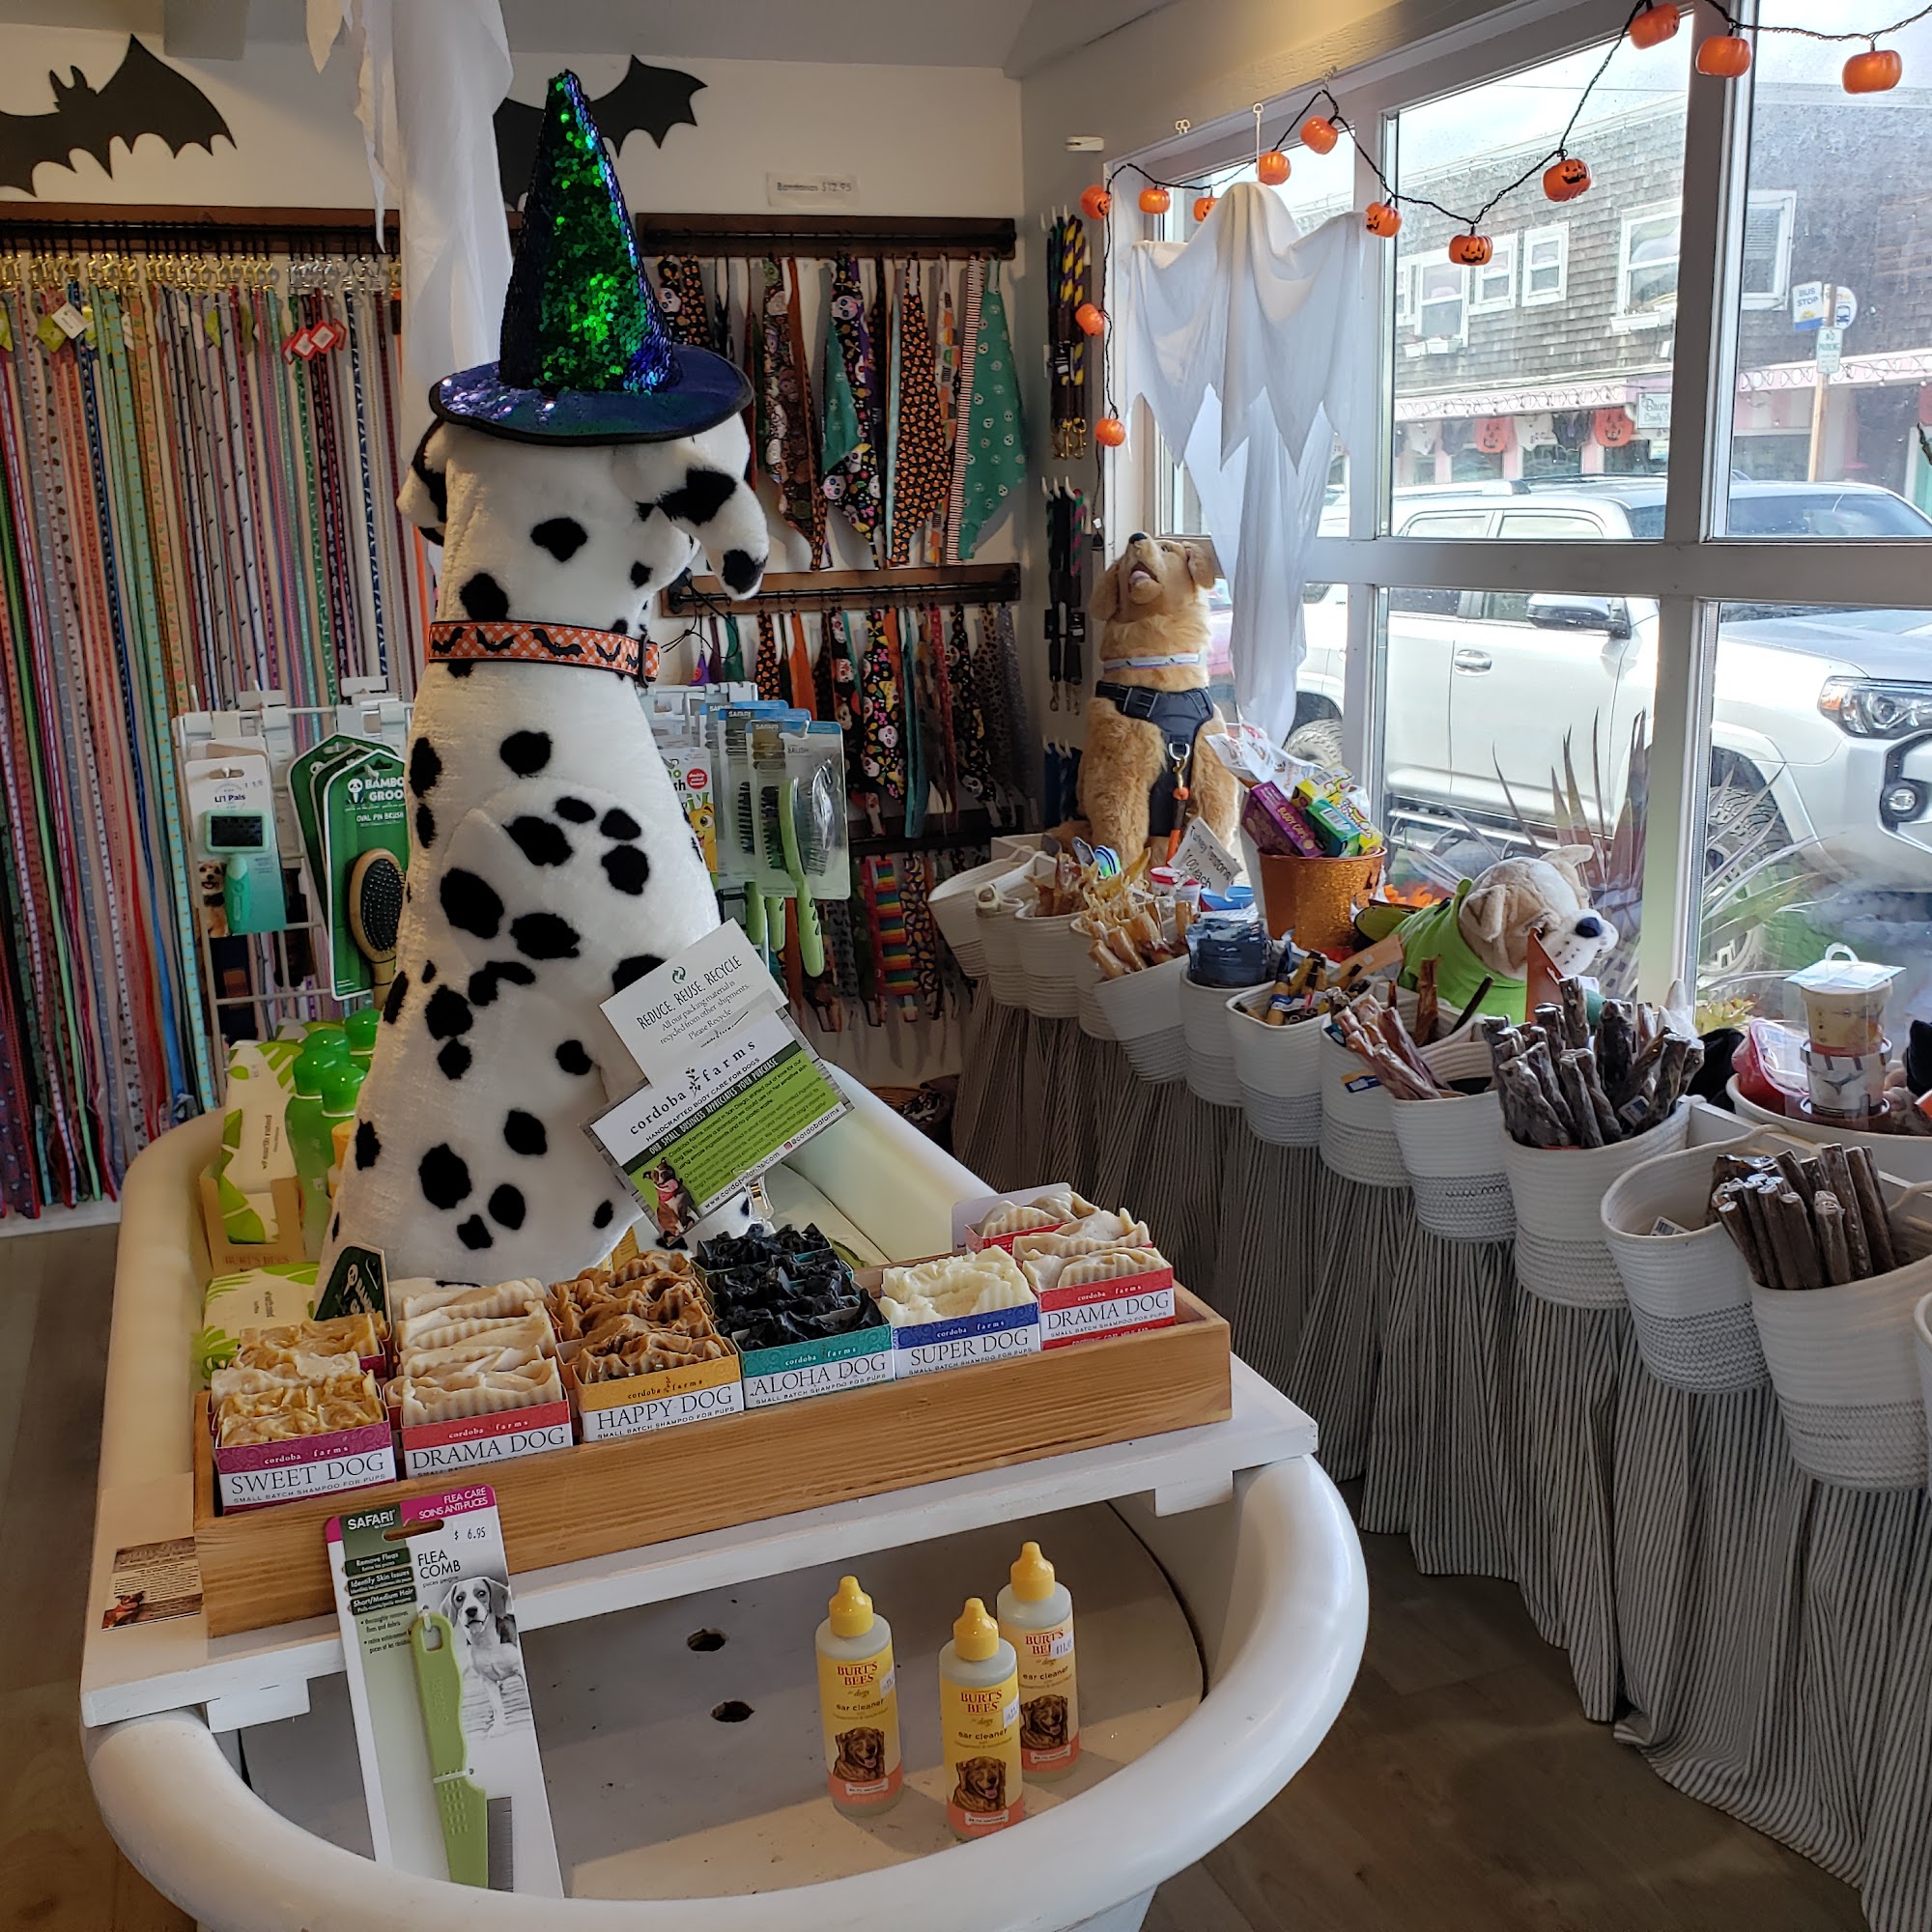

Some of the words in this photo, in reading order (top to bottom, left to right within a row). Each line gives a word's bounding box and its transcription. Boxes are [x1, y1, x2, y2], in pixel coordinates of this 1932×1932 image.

[1797, 297, 1819, 306] STOP
[1799, 288, 1815, 297] BUS
[636, 997, 675, 1030] REDUCE.
[673, 978, 706, 1006] REUSE.
[703, 953, 742, 985] RECYCLE
[660, 1019, 671, 1031] All
[670, 1013, 683, 1024] our
[681, 998, 707, 1019] packing
[703, 981, 729, 1002] material
[658, 1023, 687, 1045] recycled
[683, 1013, 700, 1028] from
[698, 1003, 717, 1018] other
[687, 1023, 708, 1039] Please
[627, 1087, 686, 1135] cordoba
[700, 1037, 756, 1082] farms
[645, 1105, 694, 1142] HANDCRAFTED
[692, 1093, 710, 1108] BODY
[710, 1079, 728, 1094] CARE
[727, 1069, 742, 1082] FOR
[741, 1057, 759, 1072] DOGS
[647, 1141, 662, 1155] OUR
[660, 1128, 680, 1146] SMALL
[678, 1109, 706, 1132] BUSINESS
[703, 1086, 738, 1114] APPRECIATES
[736, 1075, 753, 1091] YOUR
[751, 1056, 779, 1080] PURCHASE
[790, 1106, 839, 1145] @cordobafarms
[1077, 1291, 1106, 1302] cordoba
[1115, 1284, 1142, 1294] farms
[1047, 1302, 1120, 1330] DRAMA
[1125, 1292, 1170, 1316] DOG
[936, 1327, 967, 1338] cordoba
[977, 1320, 1005, 1331] farms
[1050, 1329, 1072, 1338] SMALL
[1075, 1324, 1097, 1334] BATCH
[1099, 1318, 1133, 1329] SHAMPOO
[911, 1340, 976, 1366] SUPER
[982, 1327, 1029, 1352] DOG
[784, 1354, 817, 1366] cordoba
[827, 1348, 857, 1358] farms
[909, 1367, 933, 1376] SMALL
[935, 1361, 958, 1371] BATCH
[960, 1354, 996, 1366] SHAMPOO
[997, 1350, 1012, 1359] FOR
[1014, 1347, 1033, 1355] PUPS
[752, 1365, 831, 1396] ALOHA
[838, 1353, 886, 1379] DOG
[628, 1388, 661, 1400] cordoba
[672, 1378, 703, 1391] farms
[755, 1395, 781, 1405] SMALL
[783, 1390, 809, 1400] BATCH
[810, 1381, 847, 1394] SHAMPOO
[867, 1374, 886, 1382] PUPS
[597, 1399, 673, 1431] HAPPY
[680, 1385, 733, 1414] DOG
[448, 1427, 484, 1439] cordoba
[496, 1420, 528, 1431] farms
[597, 1430, 624, 1439] SMALL
[627, 1425, 653, 1435] BATCH
[655, 1415, 695, 1429] SHAMPOO
[696, 1411, 713, 1420] FOR
[715, 1406, 735, 1416] PUPS
[264, 1453, 301, 1464] cordoba
[313, 1446, 349, 1458] farms
[412, 1439, 502, 1470] DRAMA
[510, 1427, 565, 1454] DOG
[232, 1465, 317, 1494] SWEET
[327, 1452, 384, 1481] DOG
[234, 1495, 262, 1504] SMALL
[266, 1491, 294, 1500] BATCH
[297, 1483, 340, 1495] SHAMPOO
[363, 1473, 385, 1483] PUPS
[443, 1493, 463, 1504] FLEA
[465, 1488, 487, 1499] CARE
[418, 1509, 444, 1520] SOINS
[444, 1497, 488, 1514] ANTI-PUCES
[348, 1510, 395, 1530] SAFARI
[454, 1530, 459, 1541] $
[468, 1526, 486, 1540] 6.95
[355, 1558, 381, 1567] Remove
[382, 1552, 399, 1562] Fleas
[418, 1549, 448, 1566] FLEA
[351, 1577, 376, 1588] Identify
[376, 1574, 390, 1582] Skin
[390, 1570, 410, 1579] Issues
[420, 1560, 461, 1579] COMB
[353, 1593, 398, 1607] Short/Medium
[399, 1588, 413, 1597] Hair
[1025, 1630, 1064, 1645] BURT'S
[838, 1662, 878, 1676] BURT'S
[1039, 1666, 1068, 1680] cleaner
[844, 1674, 874, 1686] BEES
[852, 1698, 884, 1711] cleaner
[960, 1690, 1003, 1703] BURT'S
[967, 1702, 999, 1713] BEES
[958, 1731, 972, 1740] ear
[975, 1728, 1008, 1740] cleaner
